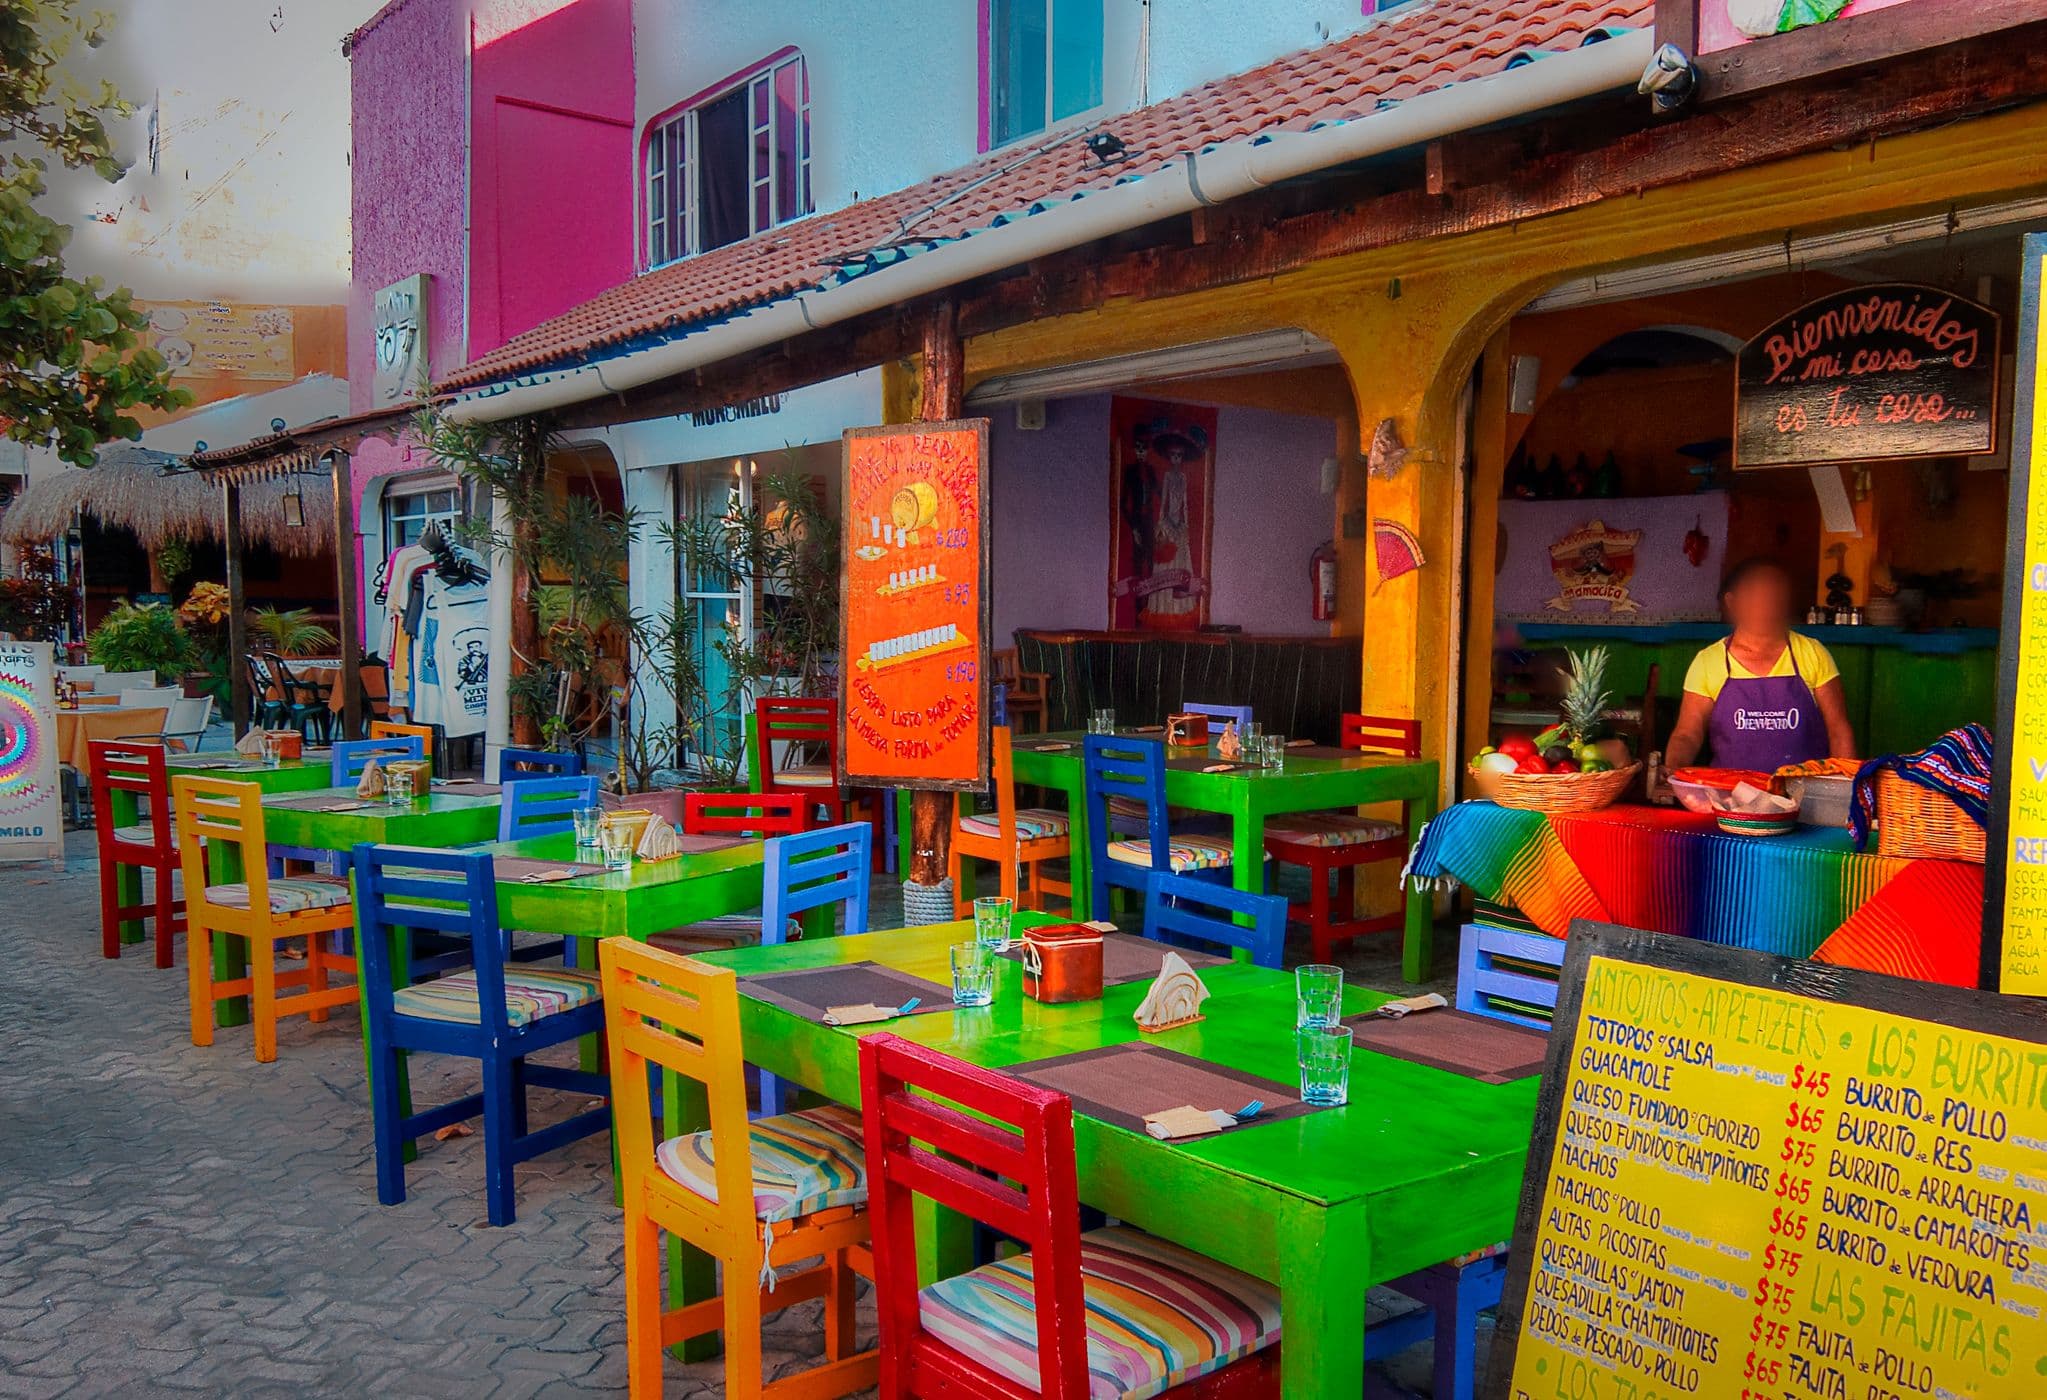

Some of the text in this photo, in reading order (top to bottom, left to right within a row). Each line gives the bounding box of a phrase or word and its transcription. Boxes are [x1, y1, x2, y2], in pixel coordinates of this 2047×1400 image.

[1764, 295, 1979, 384] Bienvenidos
[1775, 404, 1808, 432] es
[1587, 1014, 1654, 1053] TOTOPOS
[1588, 964, 1828, 1060] ANTOJITOS APPETIZERS
[1580, 1046, 1675, 1092] GUACAMOLE
[1866, 1023, 1917, 1079] LOS
[1573, 1079, 1623, 1111] QUESO
[1629, 1092, 1689, 1130] FUNDIDO
[1791, 1062, 1831, 1098] $45
[1566, 1110, 1612, 1142] QUESO
[1616, 1123, 1674, 1161] FUNDIDO
[1785, 1101, 1825, 1134] $65
[1845, 1077, 1922, 1120] BURRITO
[1941, 1097, 2007, 1143] POLLO
[1560, 1143, 1619, 1179] NACHOS
[1780, 1135, 1817, 1168] $75
[1836, 1112, 1915, 1158] BURRITO
[1933, 1136, 1972, 1174] RES
[1554, 1175, 1611, 1213] NACHOS
[1618, 1198, 1661, 1230] POLLO
[1774, 1168, 1811, 1204] $65
[1828, 1150, 1899, 1194] BURRITO
[1917, 1175, 2031, 1233] ARRACHERA
[1547, 1206, 1591, 1242] ALITAS
[1598, 1223, 1668, 1271] PICOSITAS
[1769, 1204, 1808, 1241] $65
[1822, 1187, 1898, 1233] BURRITO
[1914, 1214, 2030, 1272] CAMARONES
[1541, 1238, 1627, 1292] QUESADILLAS
[1762, 1240, 1802, 1278] $75
[1816, 1222, 1887, 1267] BURRITO
[1907, 1251, 1995, 1305] VERDURA
[1534, 1270, 1611, 1322] QUESADILLA
[1754, 1276, 1795, 1315] $75
[1810, 1264, 2012, 1377] LAS FAJITAS
[1530, 1301, 1571, 1340] DEDOS
[1584, 1323, 1643, 1369] PESCADO
[1654, 1353, 1699, 1393] POLLO
[1750, 1313, 1791, 1350] $75
[1798, 1320, 1855, 1367] FAJITA
[1874, 1348, 1933, 1394] POLLO
[1556, 1355, 1600, 1400] LOS
[1743, 1350, 1782, 1386] $65
